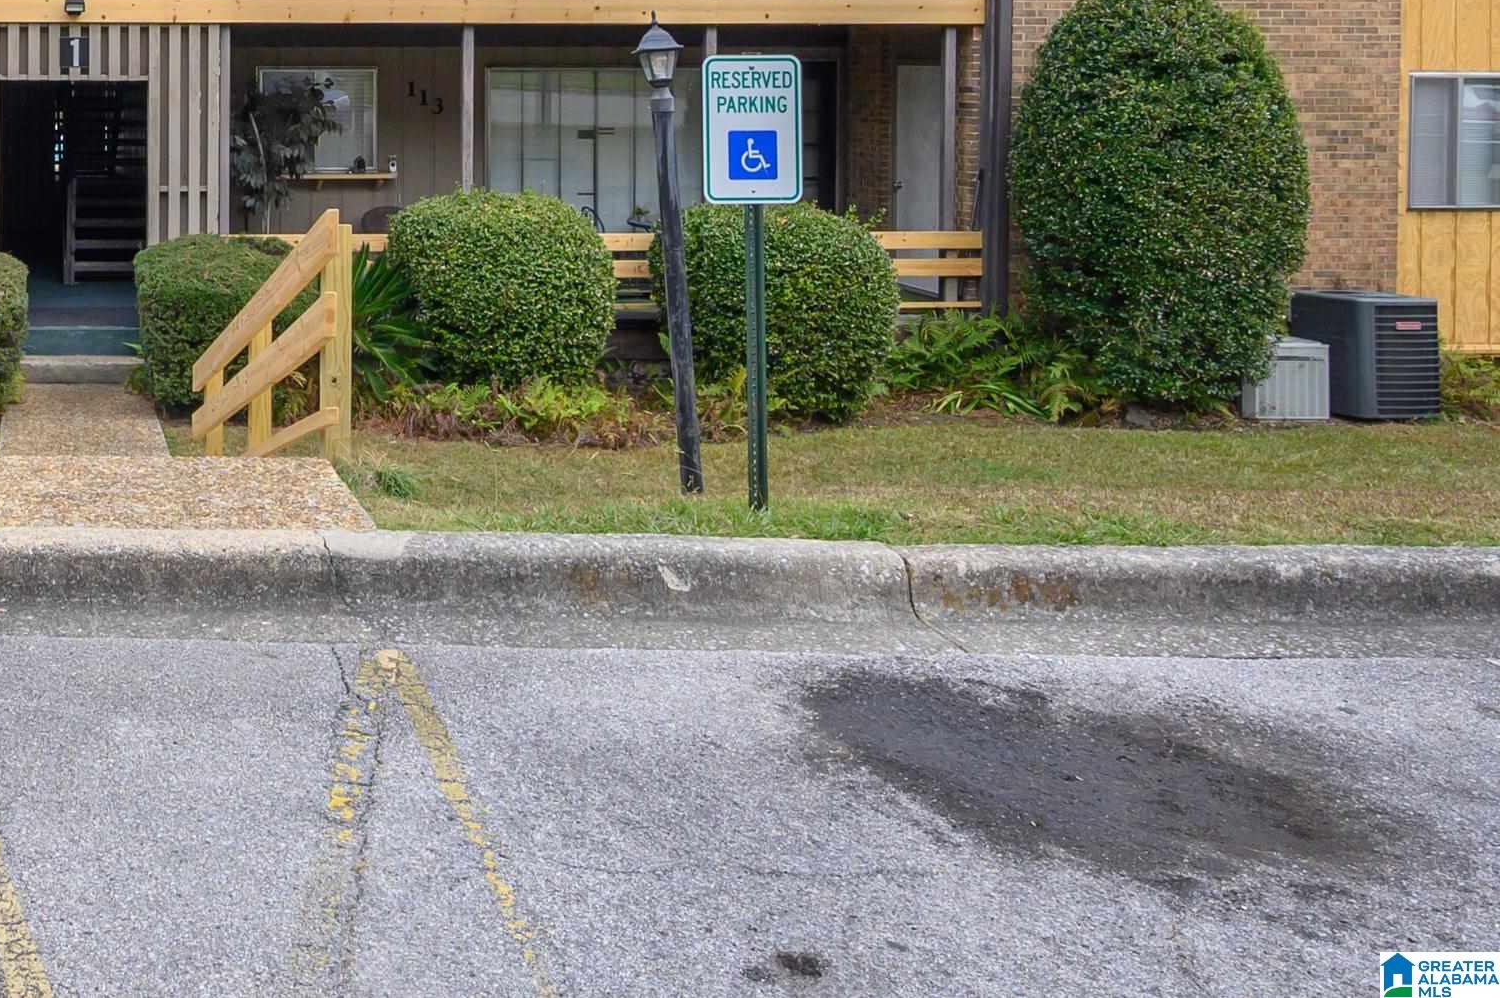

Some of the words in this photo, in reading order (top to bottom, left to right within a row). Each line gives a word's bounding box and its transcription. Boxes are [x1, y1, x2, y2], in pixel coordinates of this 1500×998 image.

[70, 38, 80, 67] 1
[711, 71, 793, 89] RESERVED
[717, 96, 788, 114] PARKING
